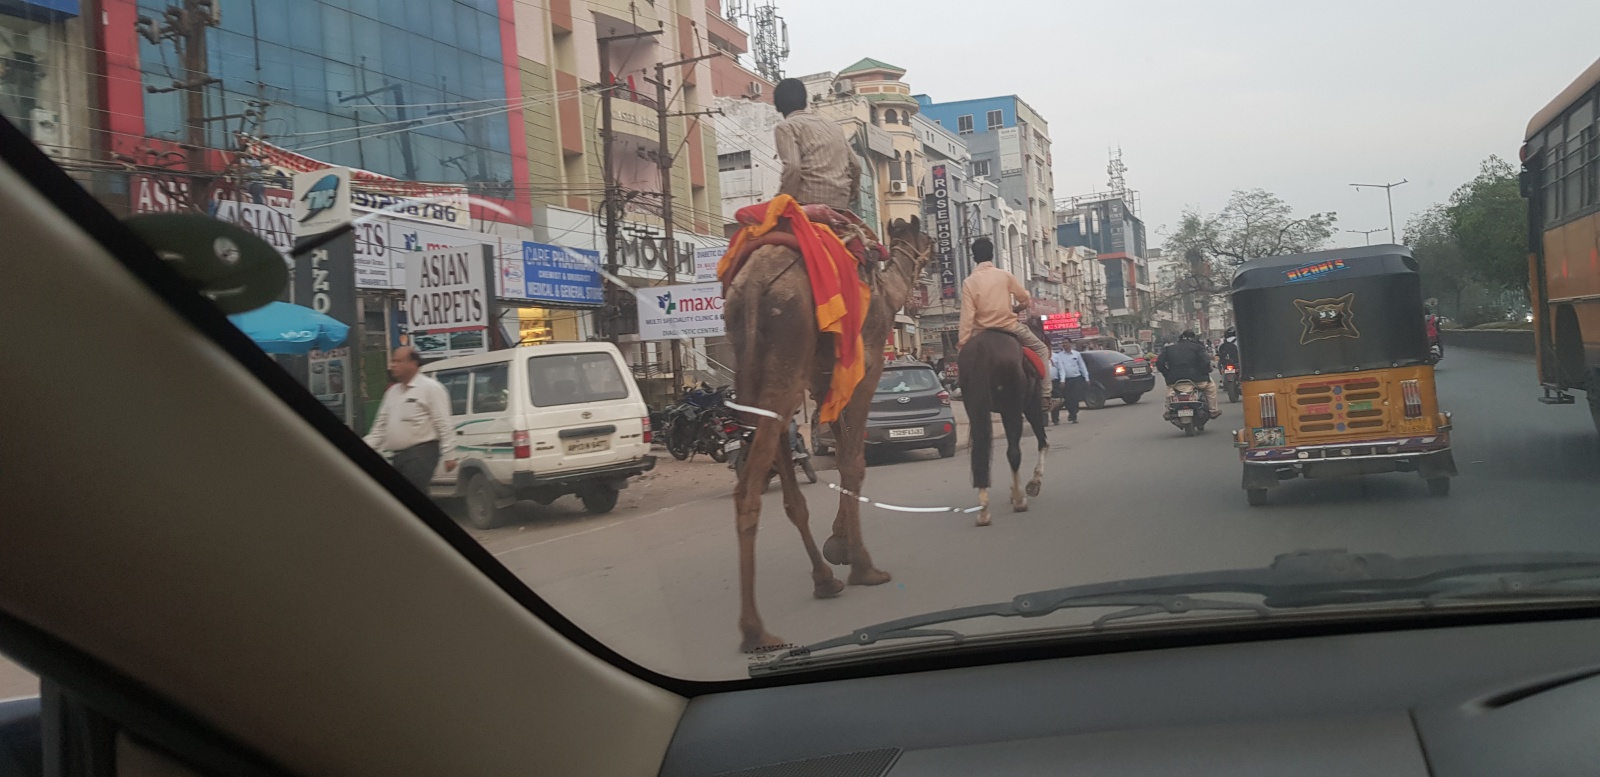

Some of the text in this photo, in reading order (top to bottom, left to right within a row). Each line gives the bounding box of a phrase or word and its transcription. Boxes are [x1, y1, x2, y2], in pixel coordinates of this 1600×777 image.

[353, 222, 385, 257] ETS
[935, 178, 953, 284] ROSE HOSPITAL
[420, 252, 470, 288] ASIAN
[525, 246, 551, 267] CARE
[527, 282, 554, 296] MEDICAL
[555, 285, 560, 296] &
[560, 285, 585, 299] GENERAL
[411, 288, 482, 326] CARPETS
[662, 316, 694, 325] SPECIALITY
[695, 314, 713, 322] CLINIC
[696, 326, 719, 335] CENTRE
